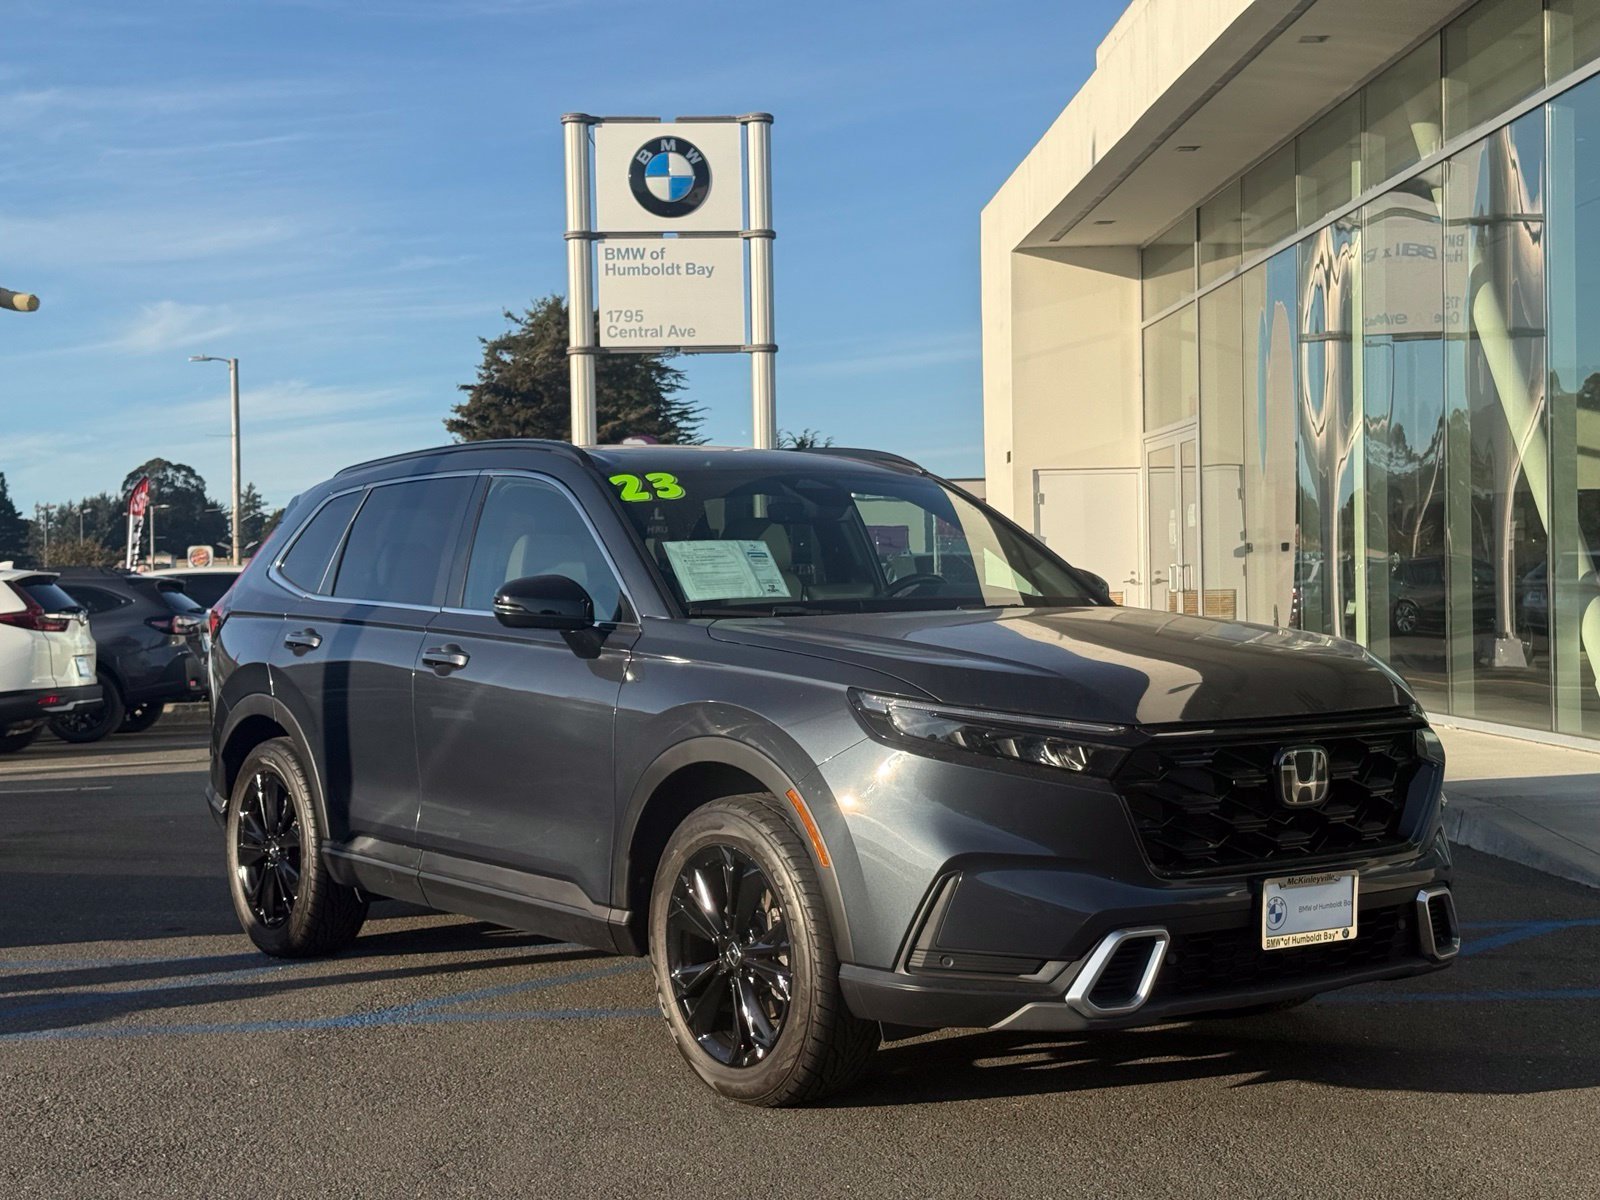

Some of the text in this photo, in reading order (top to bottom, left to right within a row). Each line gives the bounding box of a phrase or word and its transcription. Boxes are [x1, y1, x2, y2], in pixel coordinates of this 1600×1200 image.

[637, 139, 702, 165] BMW
[604, 247, 666, 261] BMW of
[604, 262, 714, 279] Humboldt Bay
[606, 310, 644, 323] 1795
[606, 325, 696, 338] Central Ave
[609, 472, 687, 502] 23
[1286, 873, 1335, 886] McKinleyville
[1298, 905, 1312, 913] BMW
[1319, 901, 1343, 910] Humboldt
[1343, 899, 1352, 907] Ba
[1266, 931, 1337, 948] BMW of Humboldt Bay
